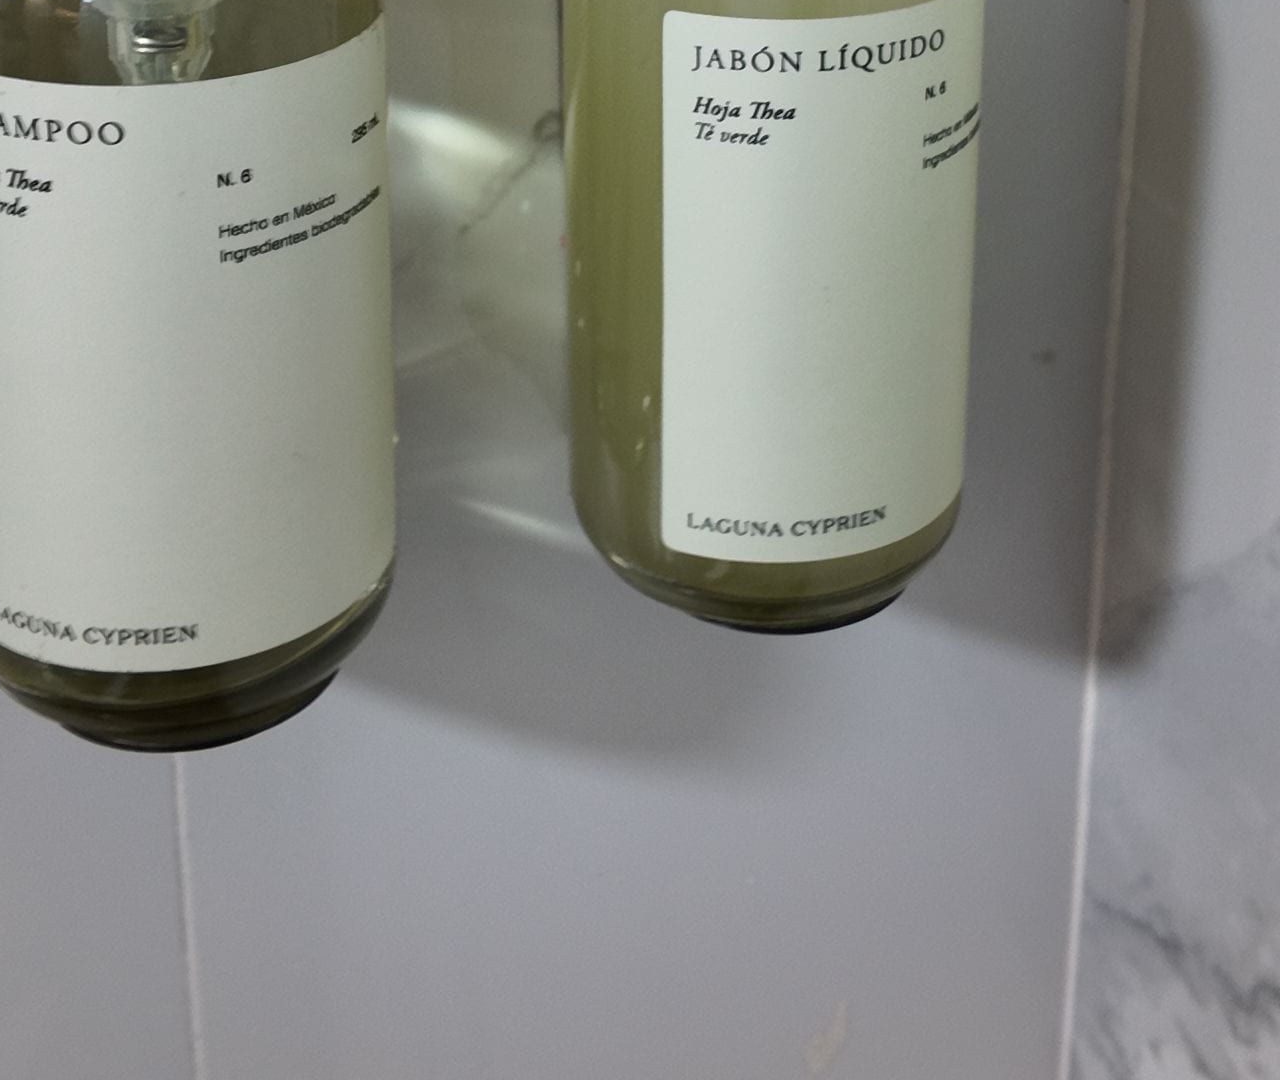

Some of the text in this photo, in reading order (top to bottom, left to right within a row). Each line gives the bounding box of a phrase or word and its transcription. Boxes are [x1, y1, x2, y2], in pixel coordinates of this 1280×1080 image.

[691, 29, 945, 73] JABÓN LÍQUIDO
[939, 80, 946, 95] 6
[693, 96, 797, 121] Hoja Thea
[694, 122, 771, 146] Té verde
[6, 168, 53, 193] Thea
[217, 169, 252, 188] N. 6
[218, 194, 336, 238] Hecho en México
[220, 230, 309, 263] Ingredientes
[687, 505, 887, 537] LAGUNA CYPRIEN
[82, 624, 199, 646] CYPRIEN
